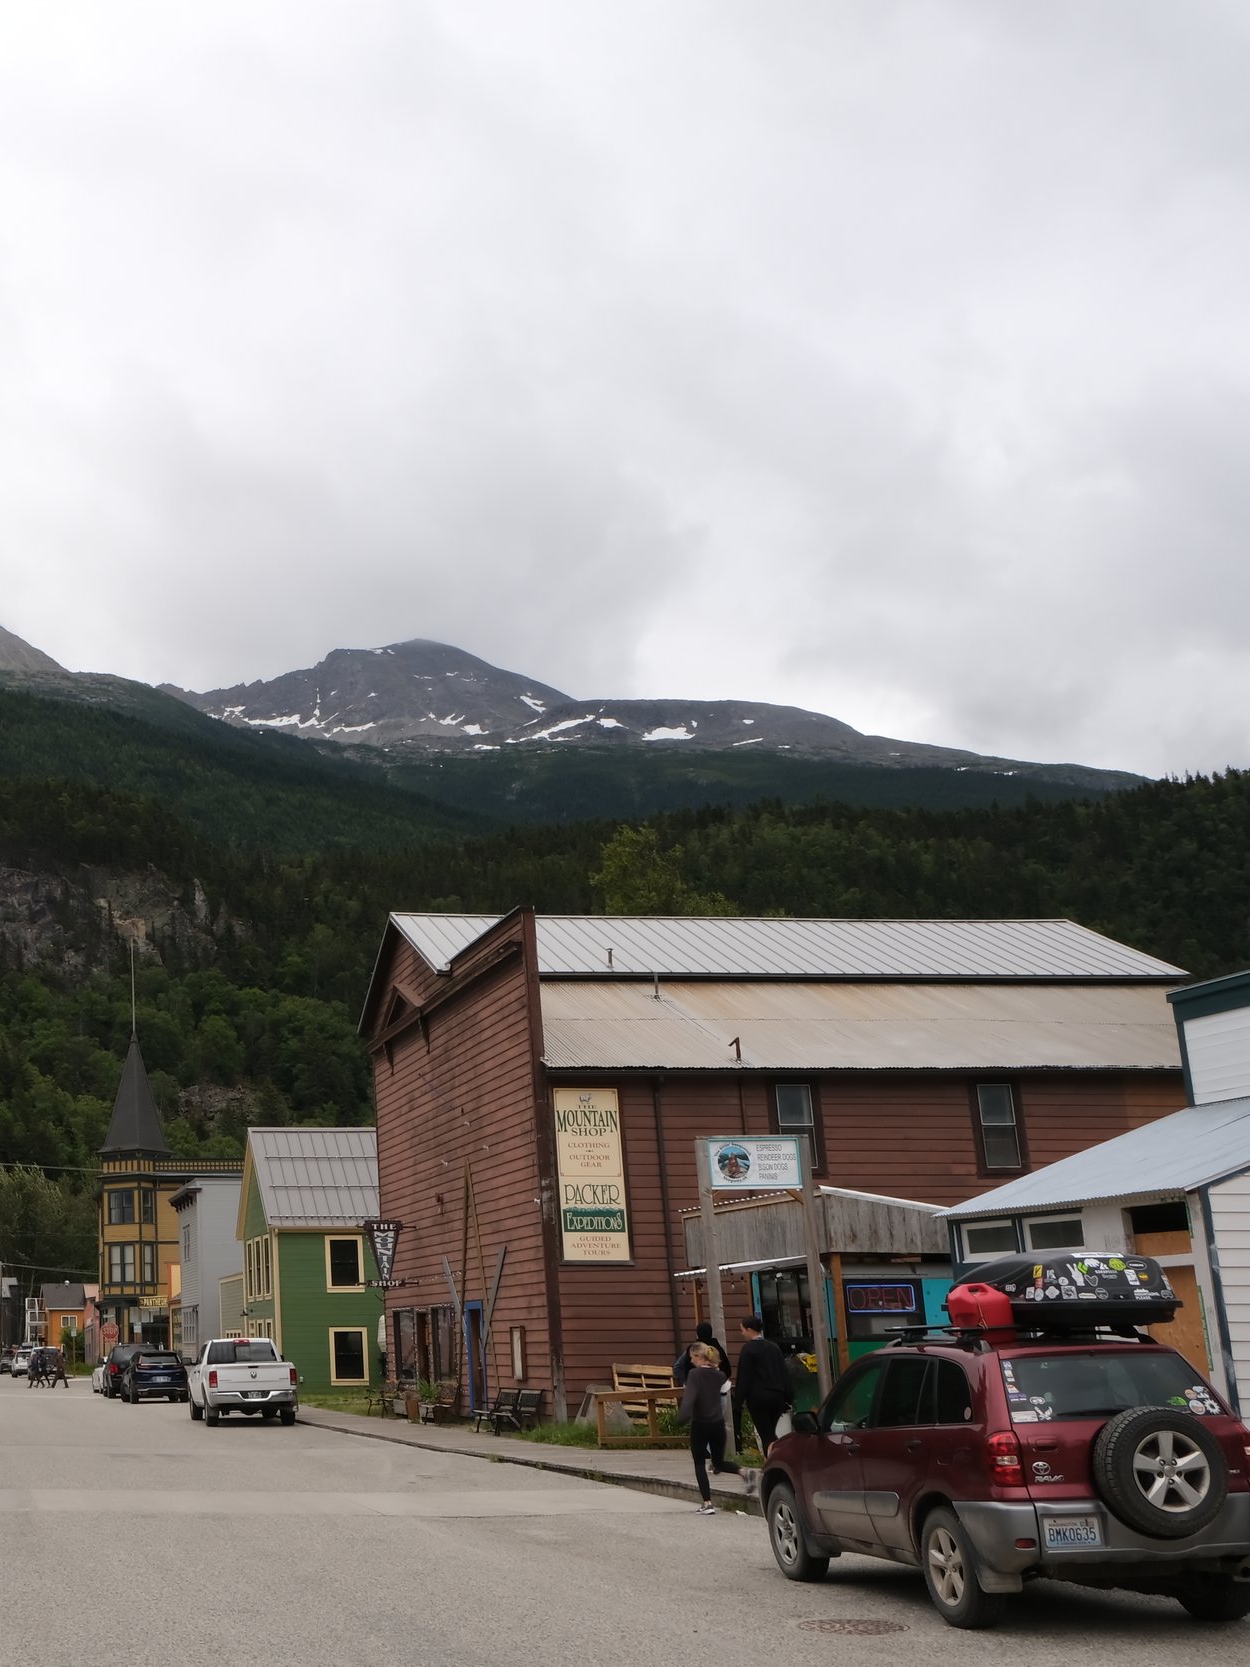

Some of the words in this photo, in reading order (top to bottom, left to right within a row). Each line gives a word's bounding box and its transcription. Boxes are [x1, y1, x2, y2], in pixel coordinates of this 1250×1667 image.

[556, 1110, 618, 1133] MOUNTAIN
[571, 1128, 607, 1136] SHOP
[757, 1153, 781, 1161] REINDEER
[564, 1184, 621, 1204] PACKER
[566, 1212, 623, 1230] EXPEDITIONS
[373, 1231, 395, 1280] MOUNTAIN
[850, 1287, 913, 1309] OPEN
[103, 1327, 118, 1335] STOP
[1049, 1527, 1097, 1542] BMK0635
